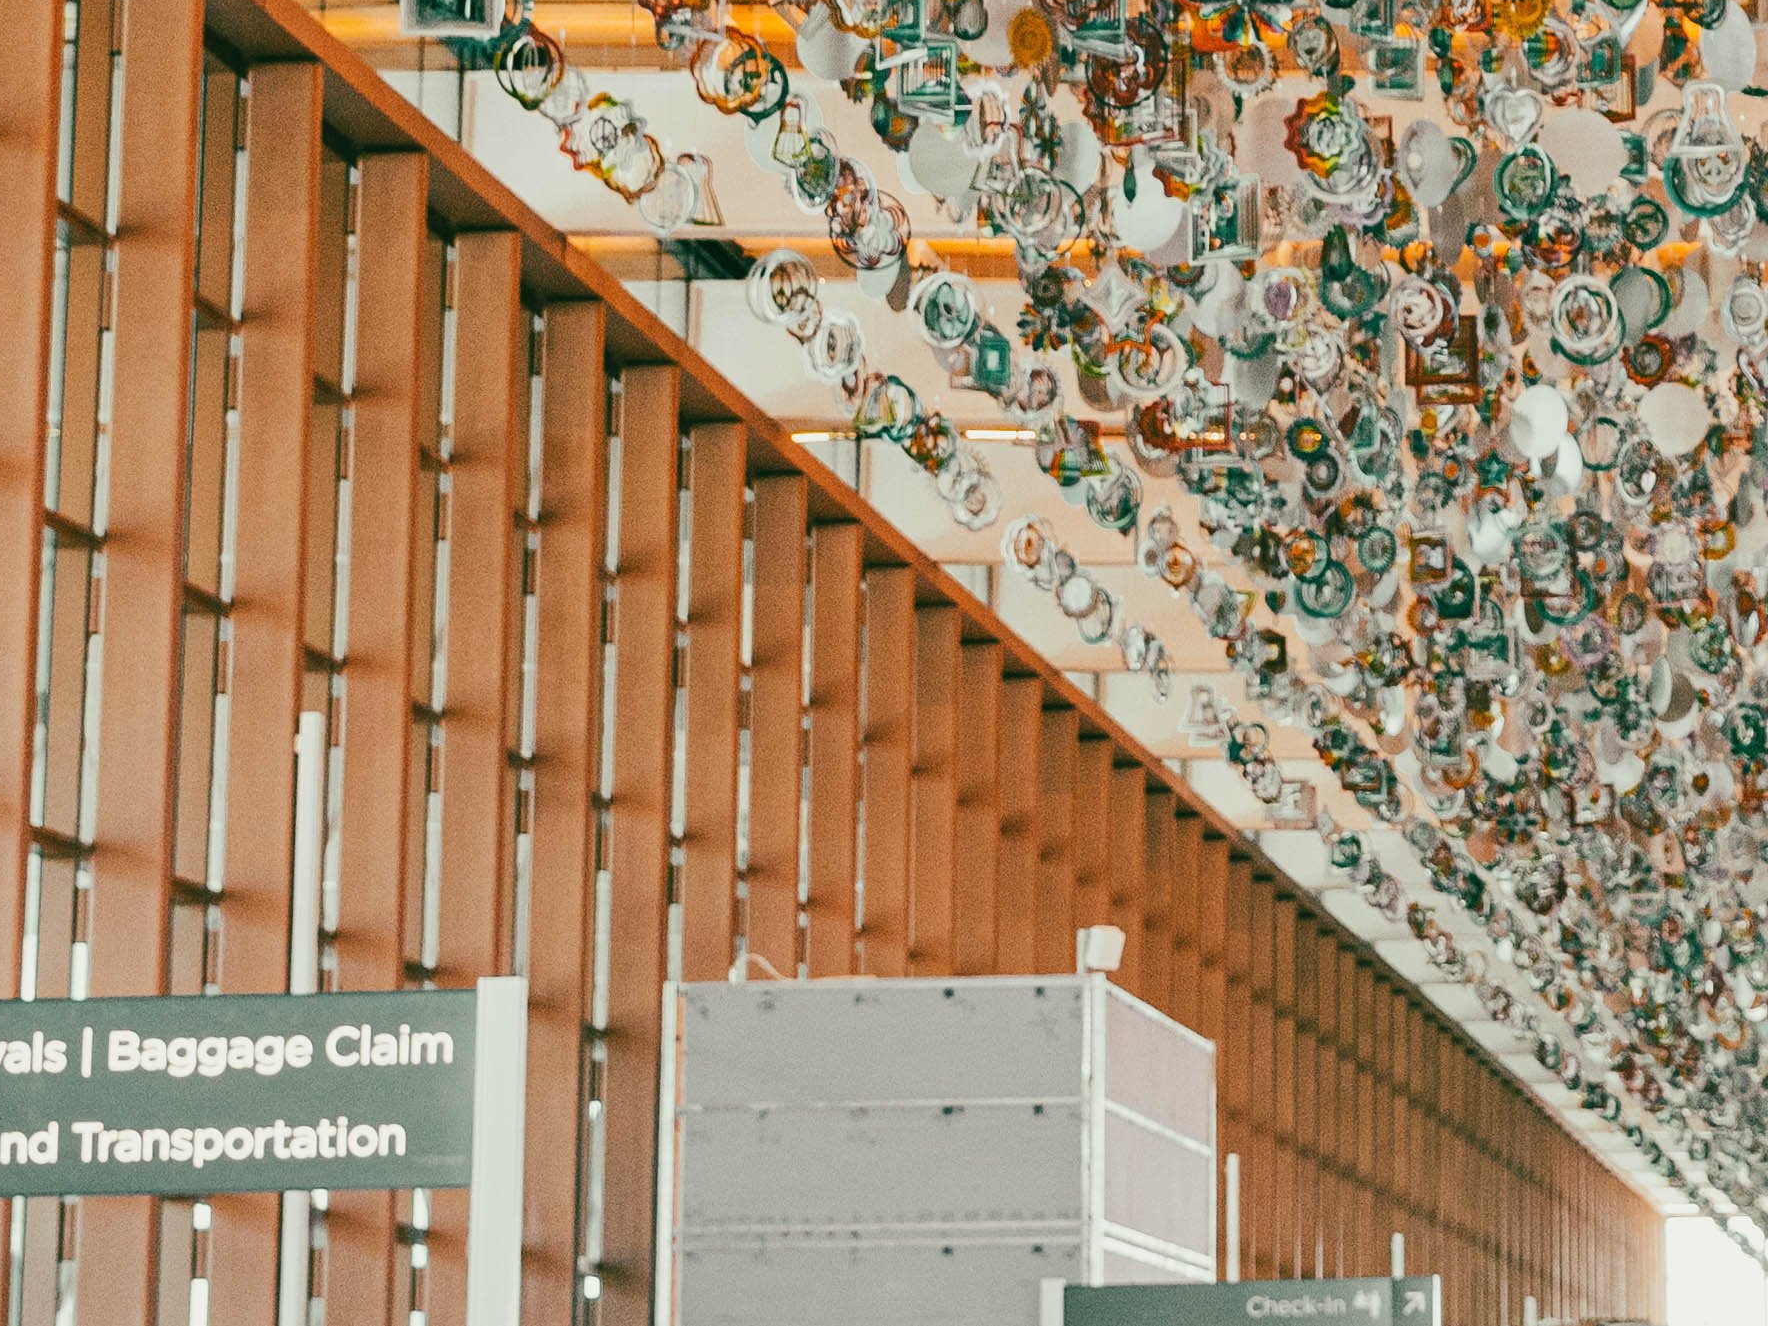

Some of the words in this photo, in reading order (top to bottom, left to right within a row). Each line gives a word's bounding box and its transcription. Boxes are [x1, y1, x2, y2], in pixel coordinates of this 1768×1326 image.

[107, 1029, 314, 1078] Baggage
[324, 1023, 455, 1067] Claim
[70, 1115, 407, 1169] Transportation
